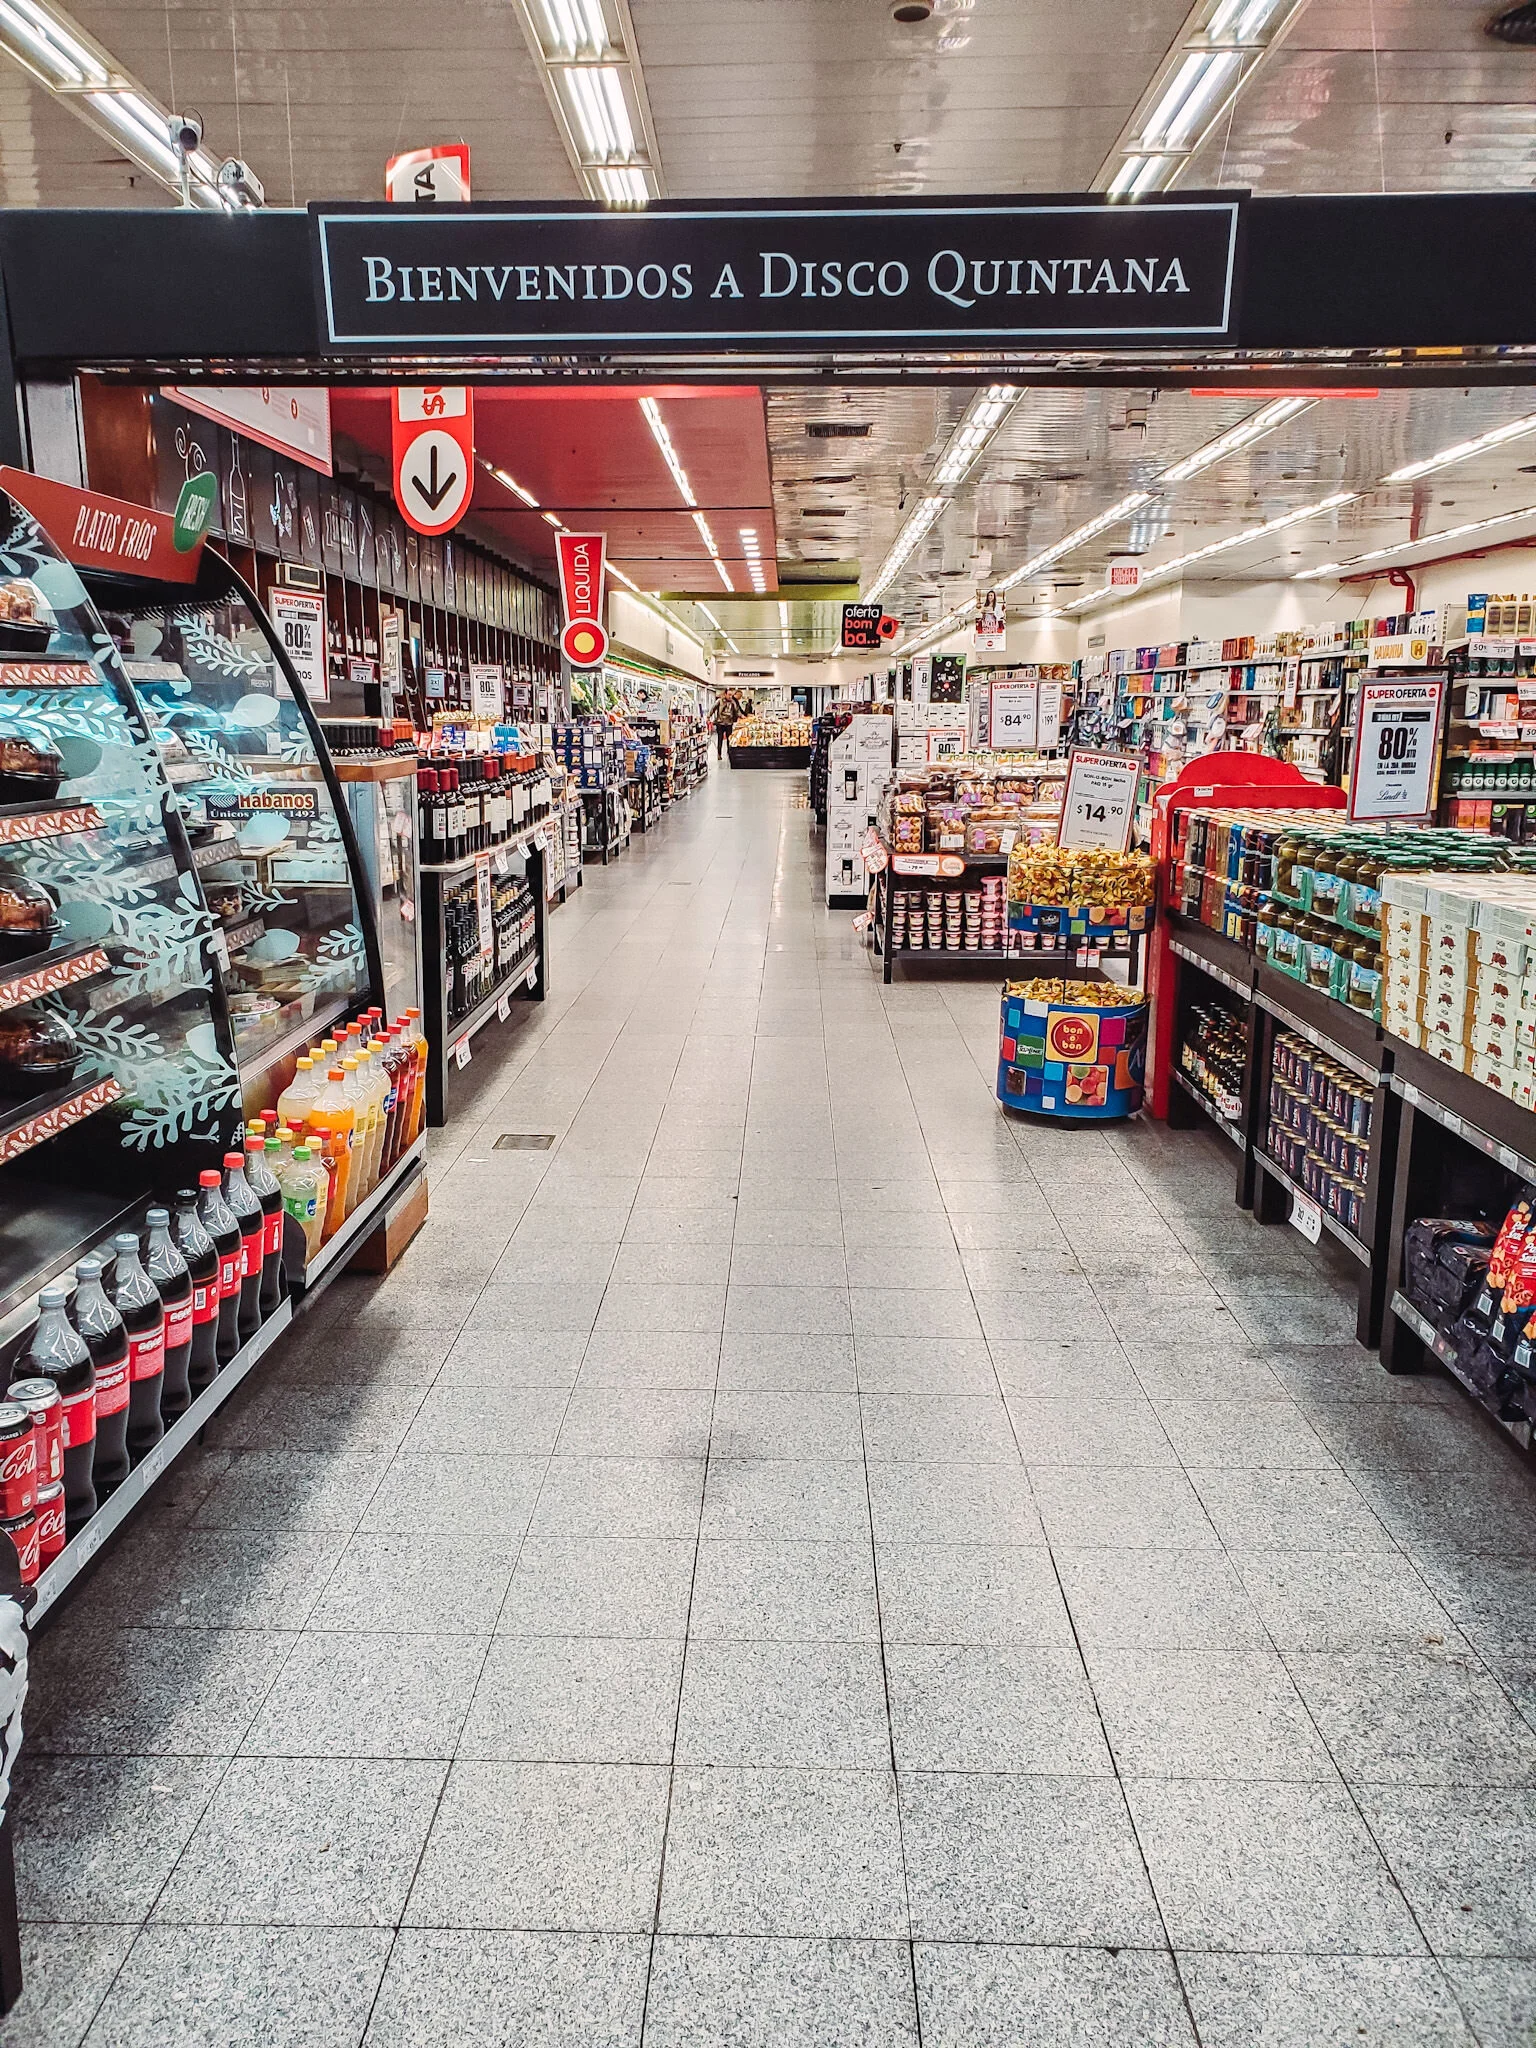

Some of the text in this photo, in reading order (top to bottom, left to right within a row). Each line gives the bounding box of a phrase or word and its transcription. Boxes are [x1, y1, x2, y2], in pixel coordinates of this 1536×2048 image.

[362, 249, 1190, 308] BIENVENIDOS A DISCO QUINTANA
[180, 493, 210, 532] FRESH
[73, 505, 157, 561] PLATOS FRÍOS
[574, 543, 591, 614] LIQUIDA
[845, 607, 879, 618] oferta
[845, 618, 872, 629] bom
[845, 632, 879, 645] ba...
[1367, 688, 1427, 699] SUPER OFERTA
[1378, 727, 1419, 760] 80%
[1076, 755, 1127, 769] SUPER OFERTA
[240, 792, 313, 808] Habanos
[210, 809, 249, 818] Únicos
[290, 810, 316, 818] 1492
[1076, 803, 1123, 822] $14.90
[1063, 1025, 1083, 1034] bon
[1062, 1040, 1082, 1050] bon
